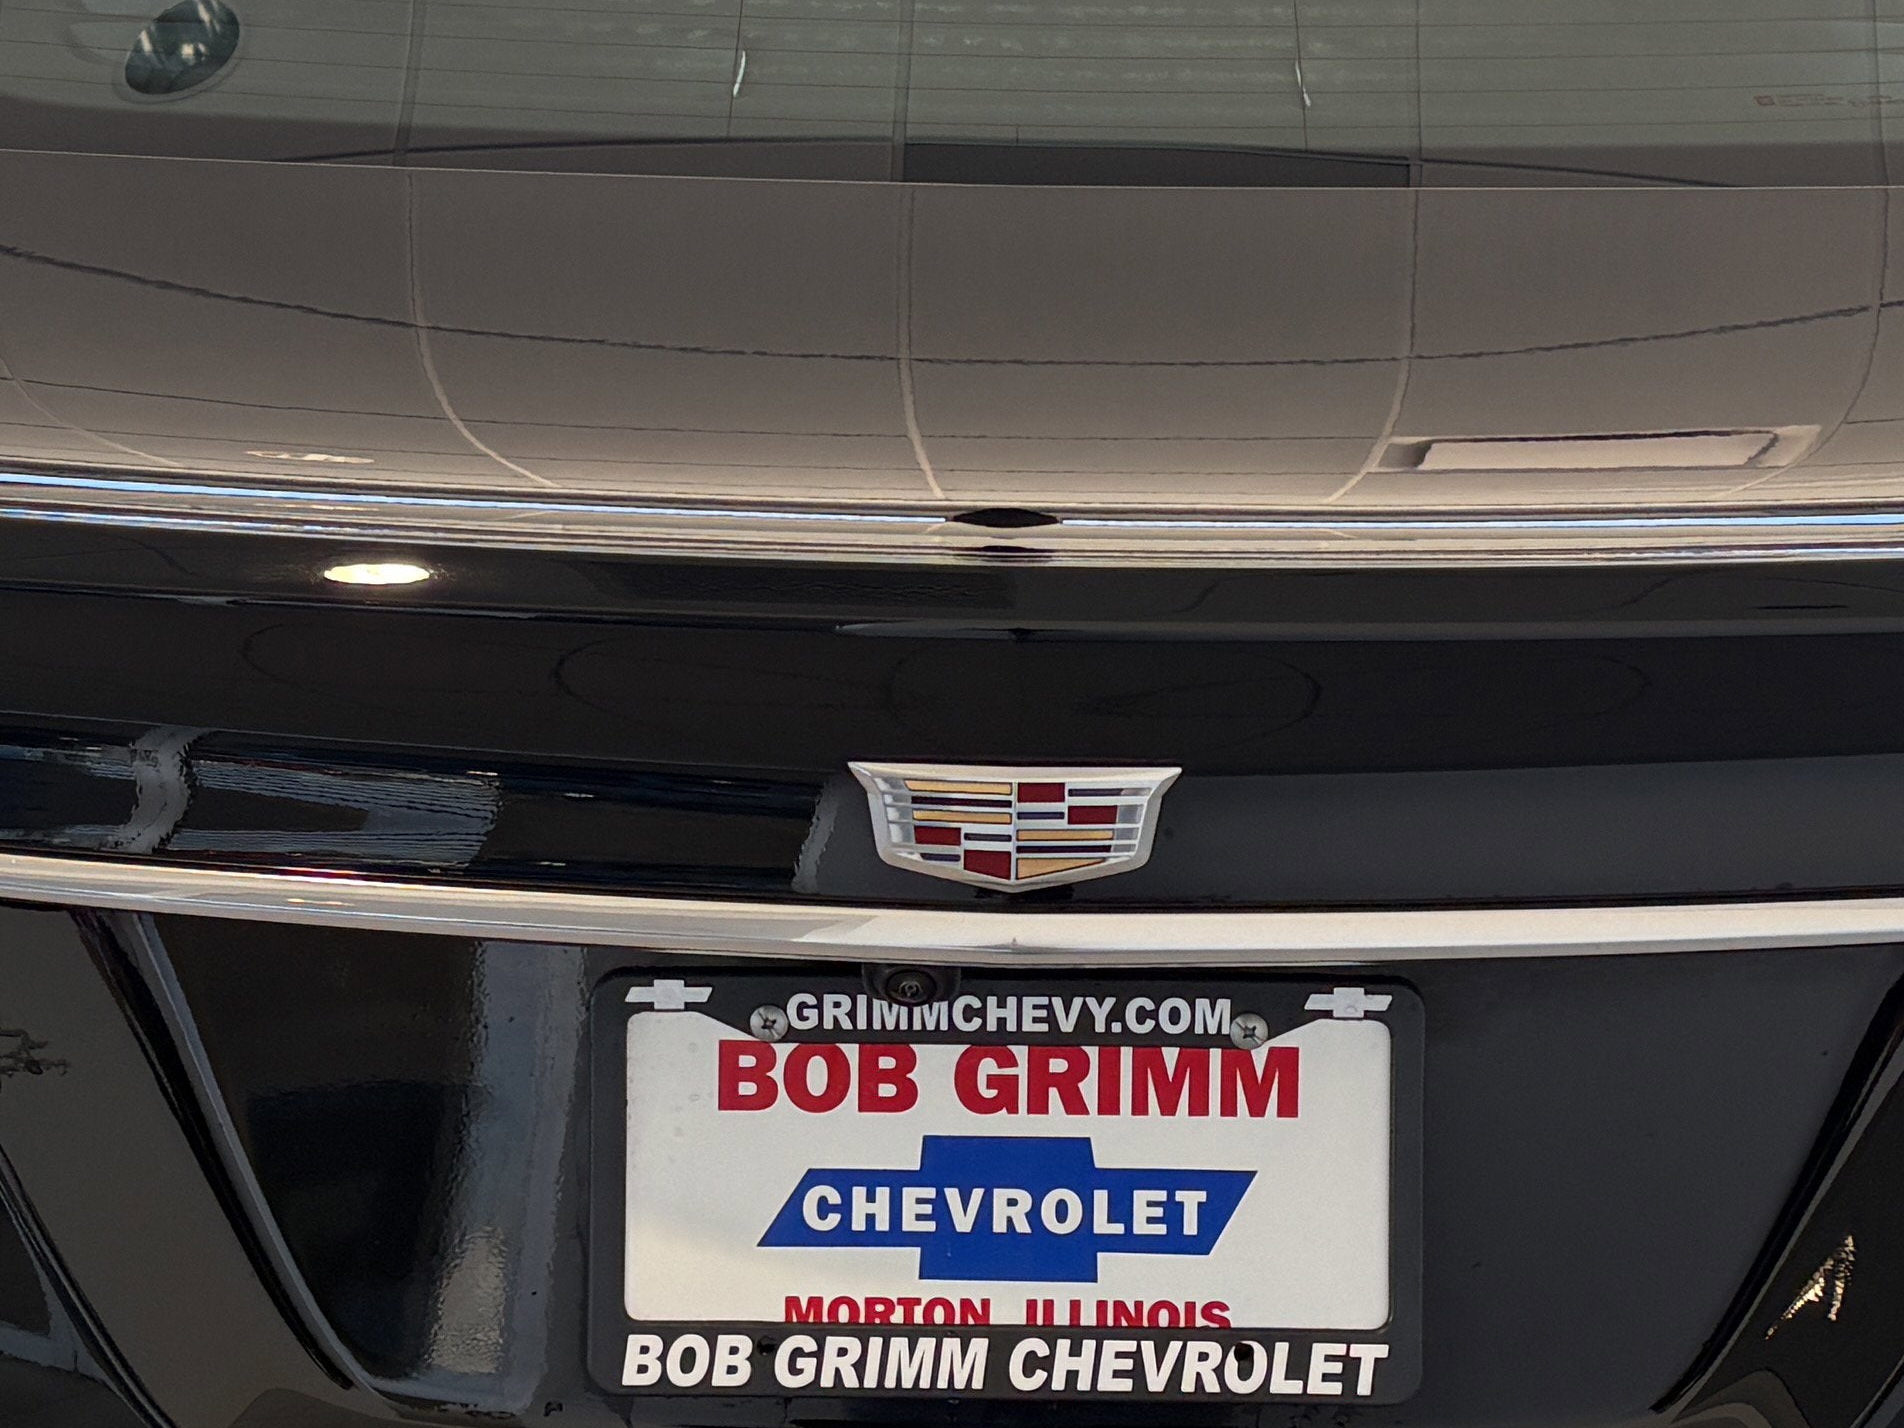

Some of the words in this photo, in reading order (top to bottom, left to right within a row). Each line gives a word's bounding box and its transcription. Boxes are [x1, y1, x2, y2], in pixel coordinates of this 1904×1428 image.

[786, 992, 1232, 1035] GRIMMCHEVY.COM
[717, 1039, 919, 1114] BOB
[953, 1044, 1300, 1119] GRIMM
[802, 1184, 1208, 1236] CHEVROLET
[621, 1333, 754, 1388] BOB
[774, 1333, 990, 1390] GRIMM
[1008, 1337, 1390, 1396] CHEVROLET
